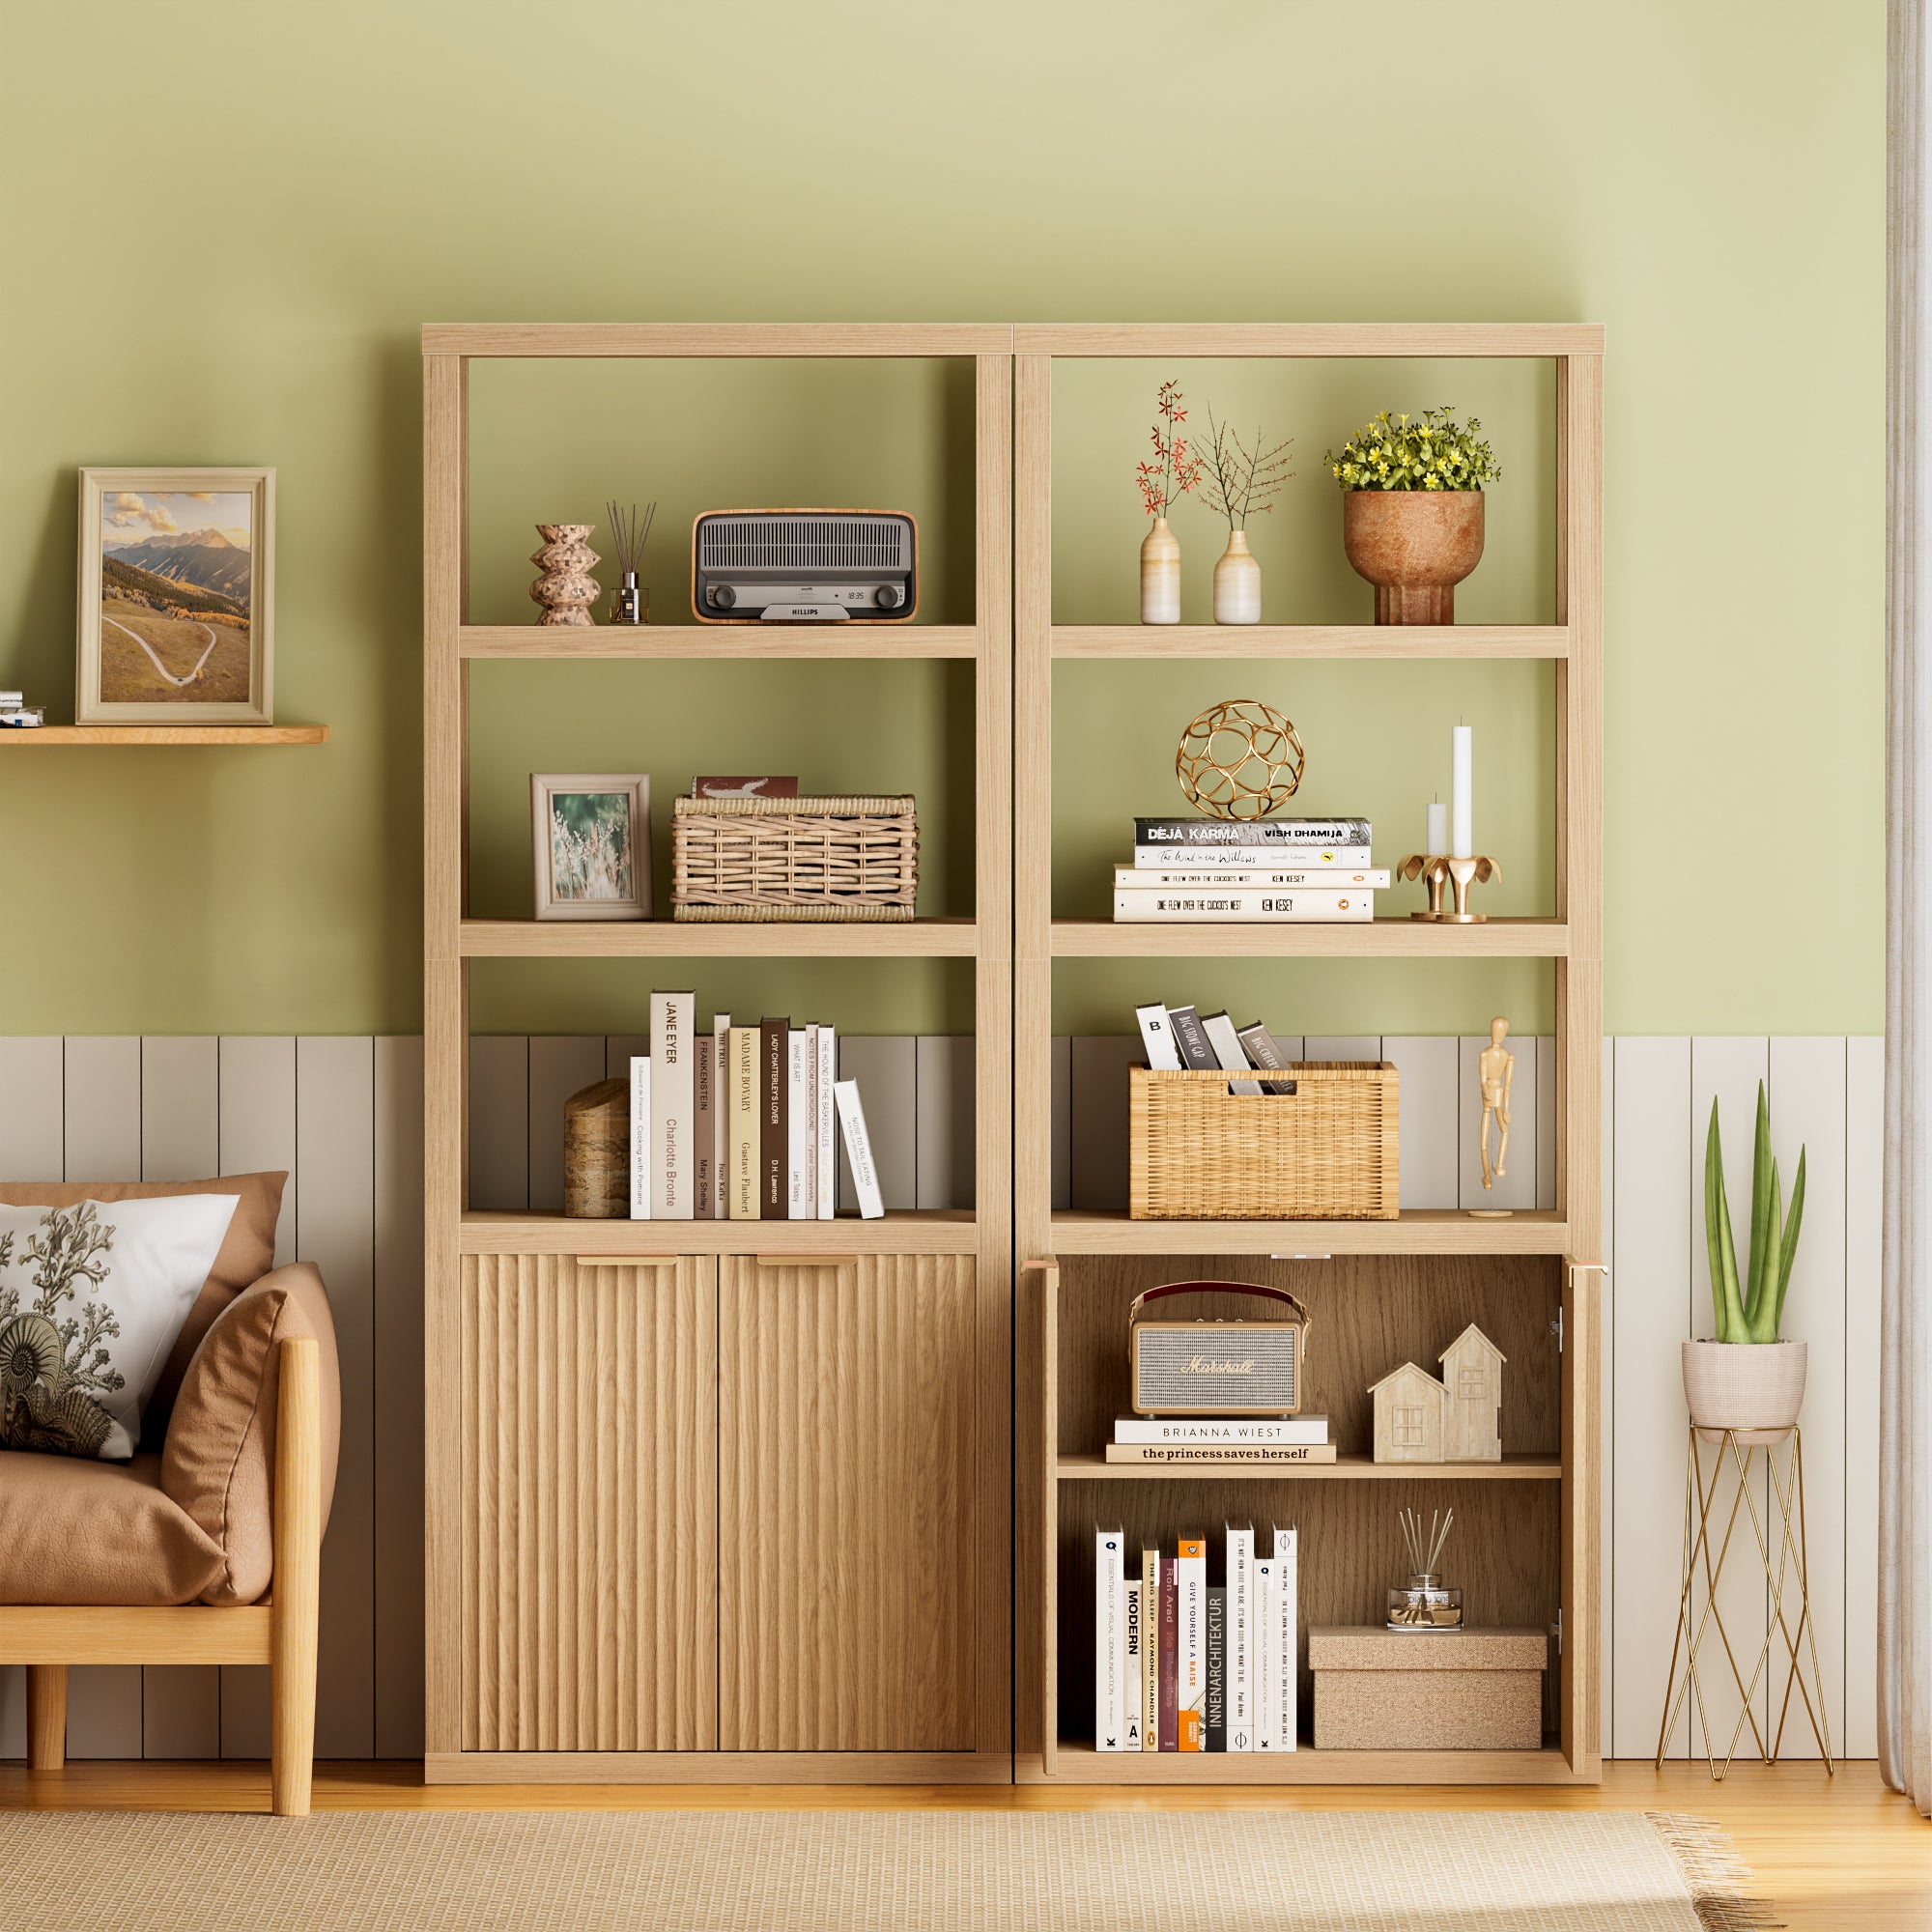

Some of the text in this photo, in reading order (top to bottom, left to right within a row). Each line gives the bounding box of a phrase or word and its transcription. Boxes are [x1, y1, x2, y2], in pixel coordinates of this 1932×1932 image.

[1189, 828, 1239, 839] KARMA
[1158, 849, 1172, 863] The
[1175, 850, 1195, 863] Wind
[1219, 850, 1256, 864] Willows
[1157, 900, 1166, 911] ONE
[1169, 900, 1180, 911] FLEW
[1182, 900, 1194, 911] OVER
[1197, 900, 1206, 911] THE
[1231, 900, 1241, 911] NEST
[1263, 899, 1293, 911] KEN KESEY
[1150, 1021, 1161, 1031] B
[1179, 1015, 1191, 1028] BIG
[666, 1002, 676, 1064] JANE EYER
[1183, 1027, 1199, 1046] STONE
[1251, 1037, 1262, 1049] BIG
[1259, 1048, 1281, 1069] CHERRY
[741, 1033, 750, 1113] MADAME BOVARY
[822, 1078, 829, 1087] OF
[667, 1119, 676, 1207] Charlotte Bronte
[741, 1143, 750, 1213] Gustave Flaubert
[862, 1162, 871, 1186] EATING
[1179, 1355, 1254, 1375] Marshall
[1163, 1428, 1282, 1437] BRIANNA WIEST
[1143, 1448, 1309, 1461] the princess saves herself
[1108, 1601, 1114, 1609] OF
[1128, 1591, 1138, 1655] MODERN
[1165, 1632, 1174, 1707] No Discipline
[1209, 1598, 1222, 1727] INNENARCHITEKTUR
[1129, 1725, 1137, 1737] A
